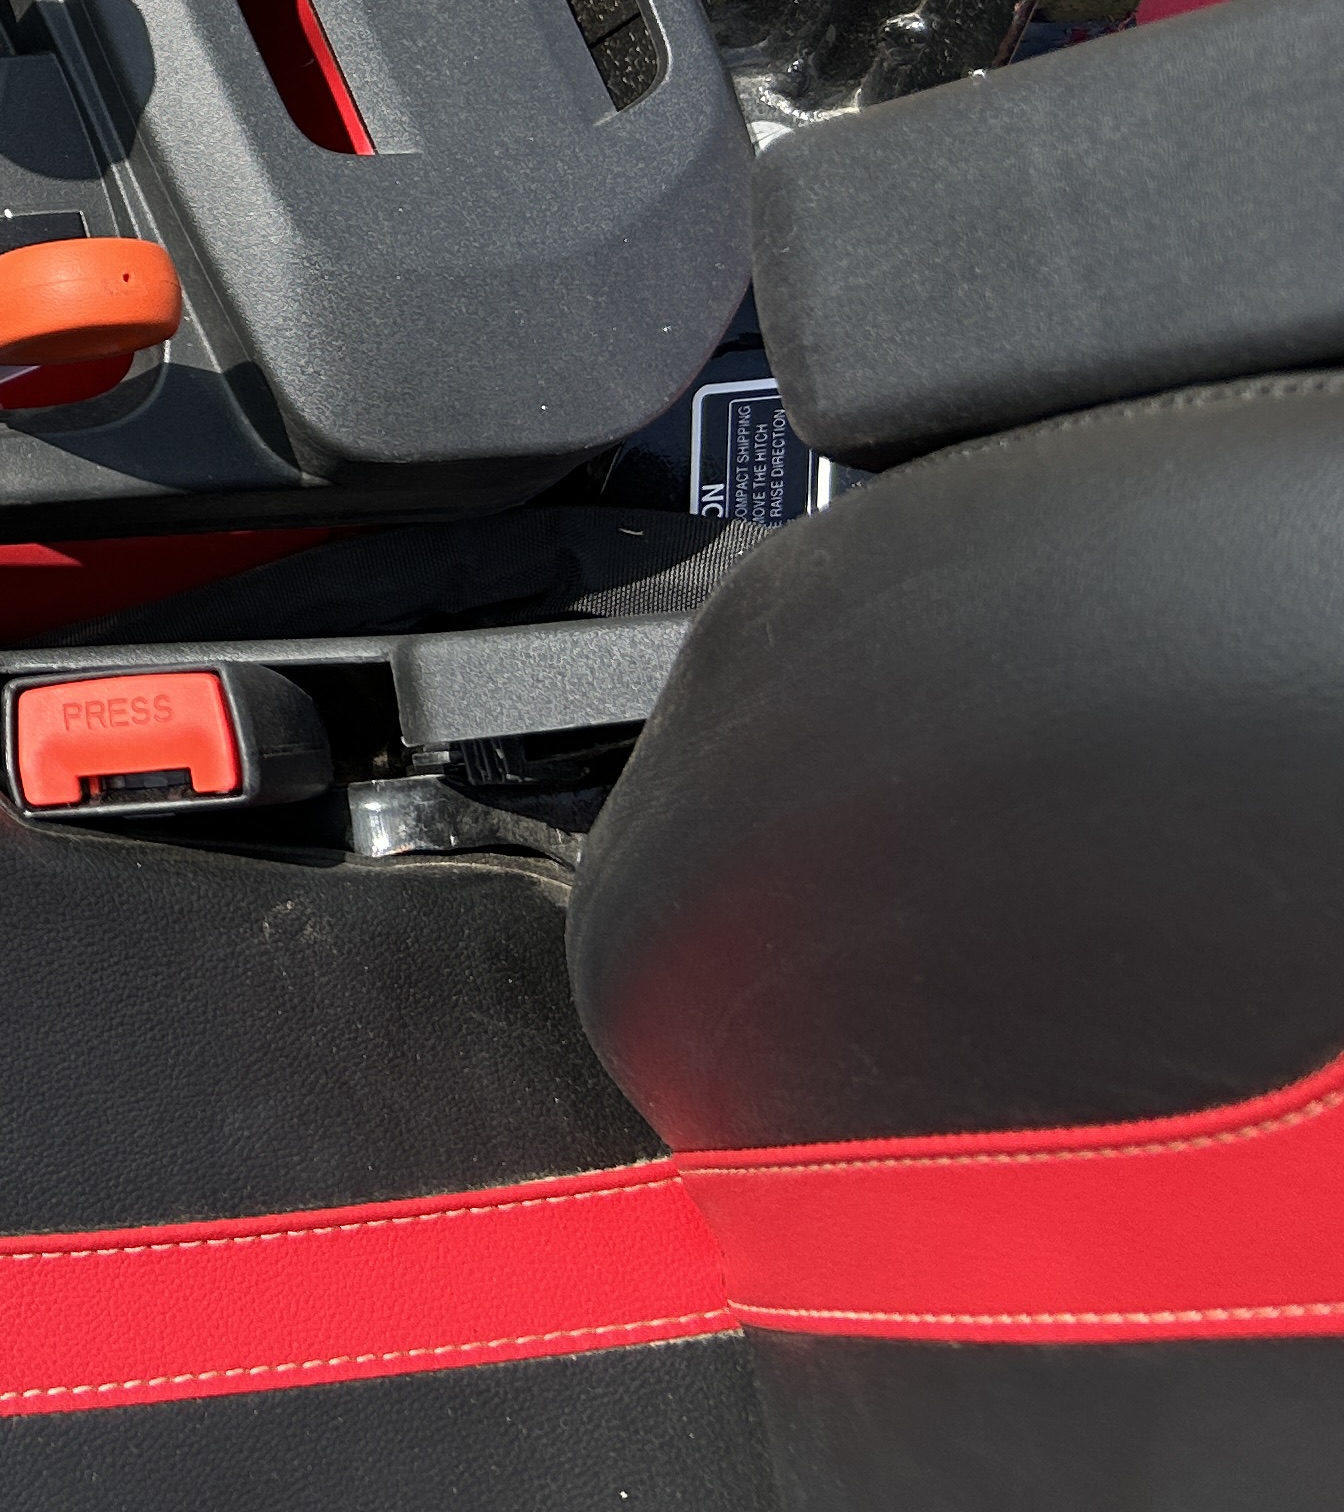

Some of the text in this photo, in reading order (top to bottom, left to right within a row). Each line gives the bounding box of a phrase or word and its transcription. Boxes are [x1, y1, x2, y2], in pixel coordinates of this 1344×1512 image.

[736, 405, 751, 464] SHIPPING
[754, 423, 768, 462] HITCH
[771, 409, 786, 478] DIRECTION
[753, 464, 767, 489] THE
[770, 480, 784, 518] RAISE
[62, 694, 175, 733] PRESS
